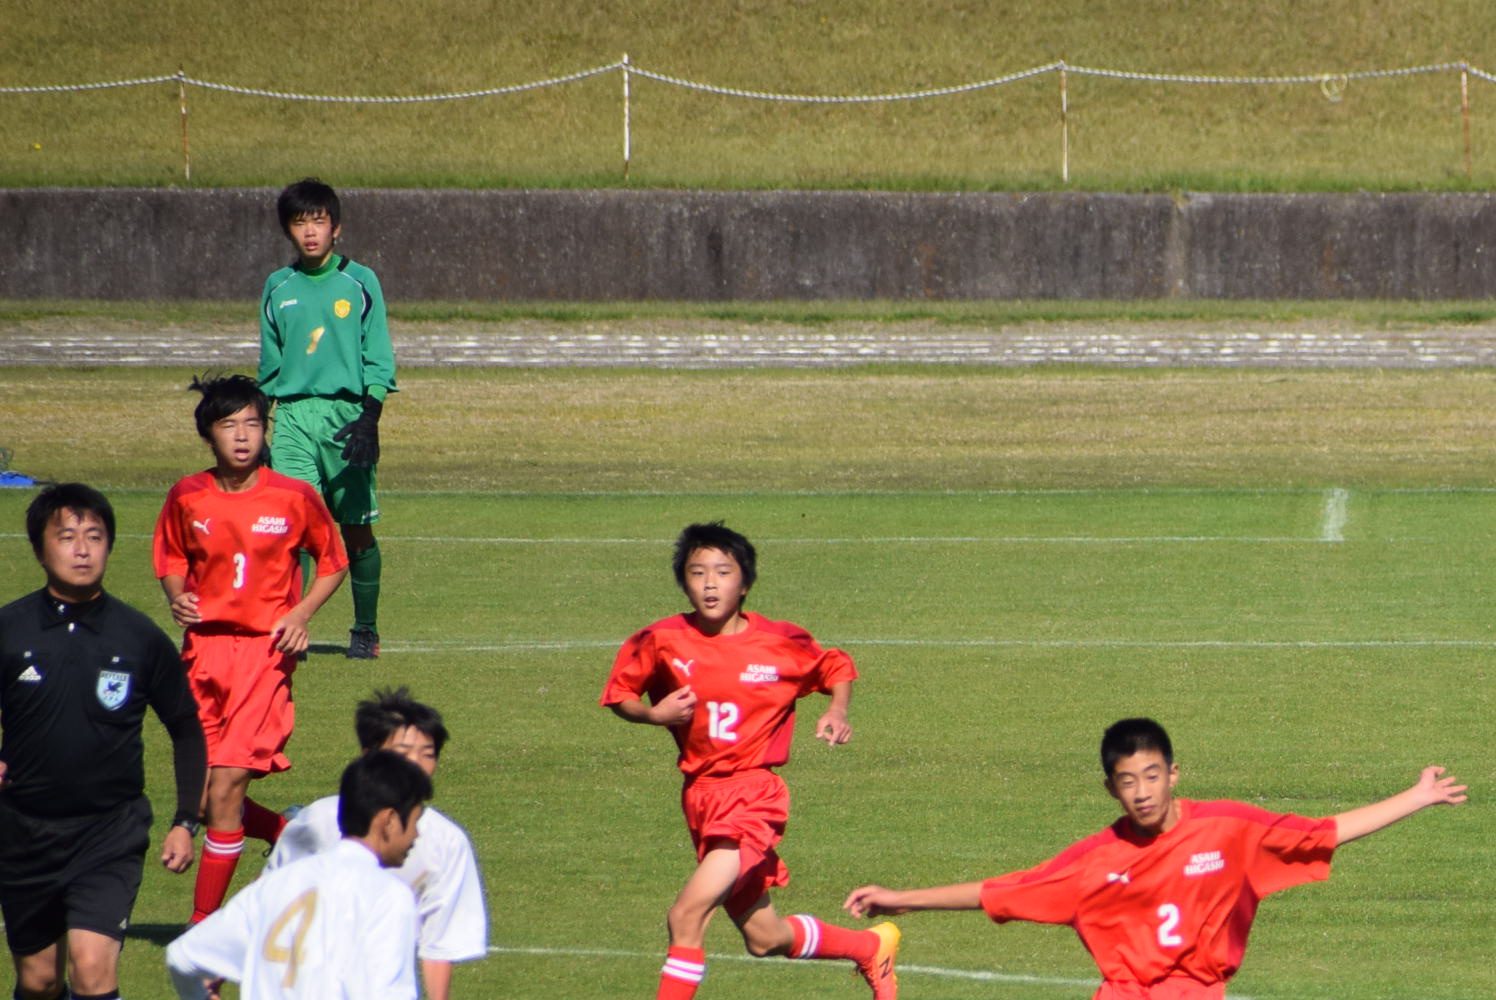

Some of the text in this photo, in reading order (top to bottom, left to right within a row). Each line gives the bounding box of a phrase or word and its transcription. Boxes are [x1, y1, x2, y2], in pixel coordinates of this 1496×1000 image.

[251, 524, 288, 534] HIGASHI
[257, 516, 286, 525] ASAHI
[233, 552, 246, 589] 3
[747, 664, 777, 673] ASAHI
[706, 701, 739, 740] 12
[1190, 850, 1221, 864] ASAHI
[1184, 859, 1224, 876] HIGASHI
[1157, 903, 1182, 947] 2
[262, 887, 318, 988] 4
